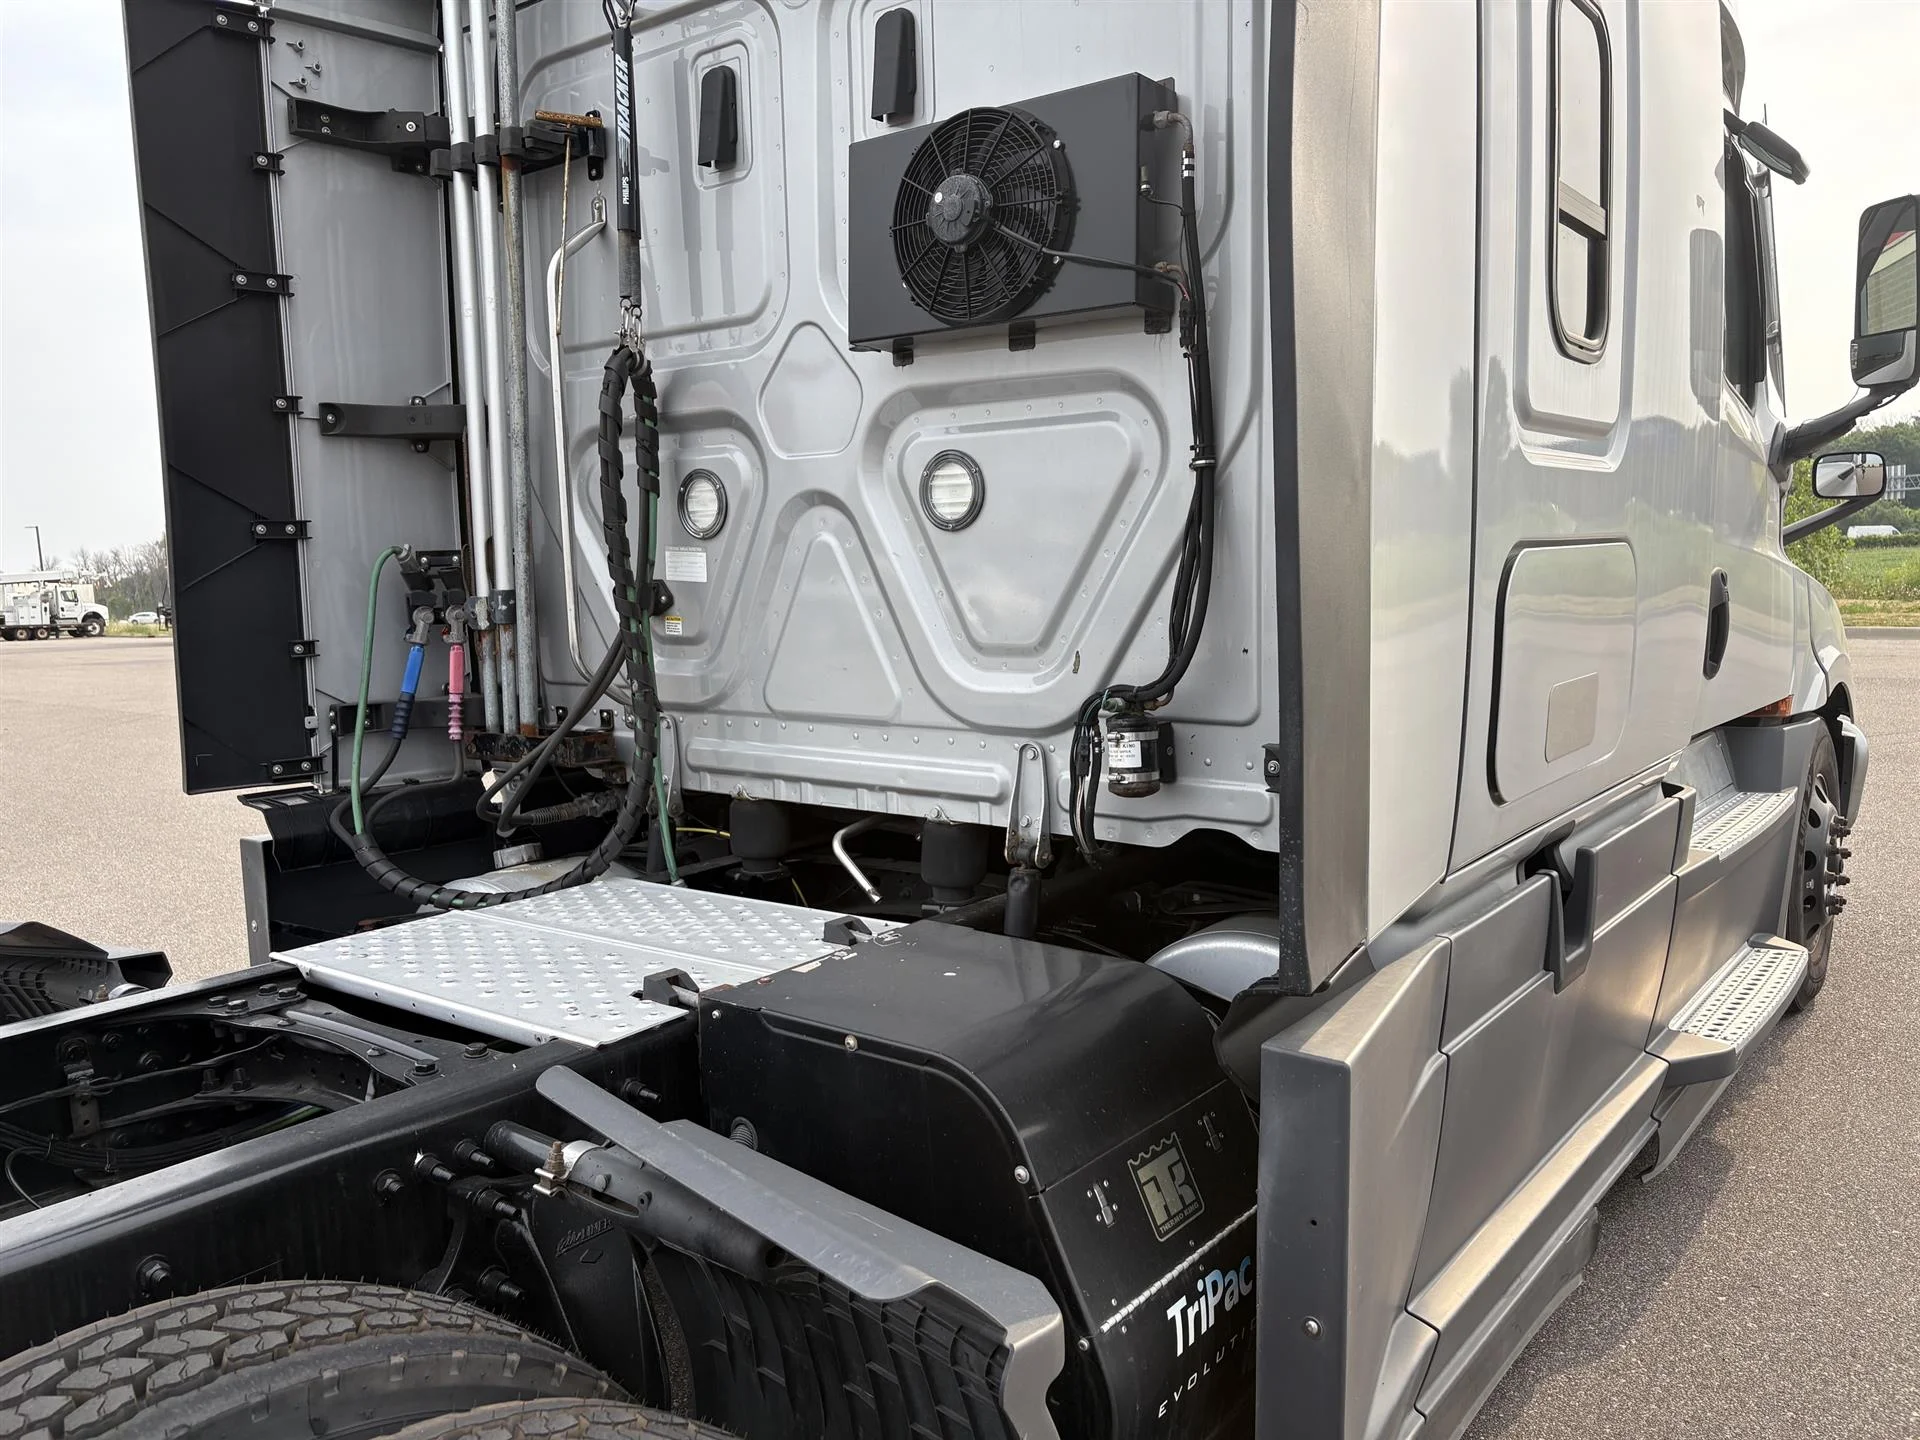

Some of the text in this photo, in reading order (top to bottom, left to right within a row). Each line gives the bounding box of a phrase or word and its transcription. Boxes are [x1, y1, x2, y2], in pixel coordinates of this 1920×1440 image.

[615, 53, 630, 143] TRACKER
[1160, 1201, 1200, 1234] THERMO KING
[1166, 1255, 1254, 1358] TriPac
